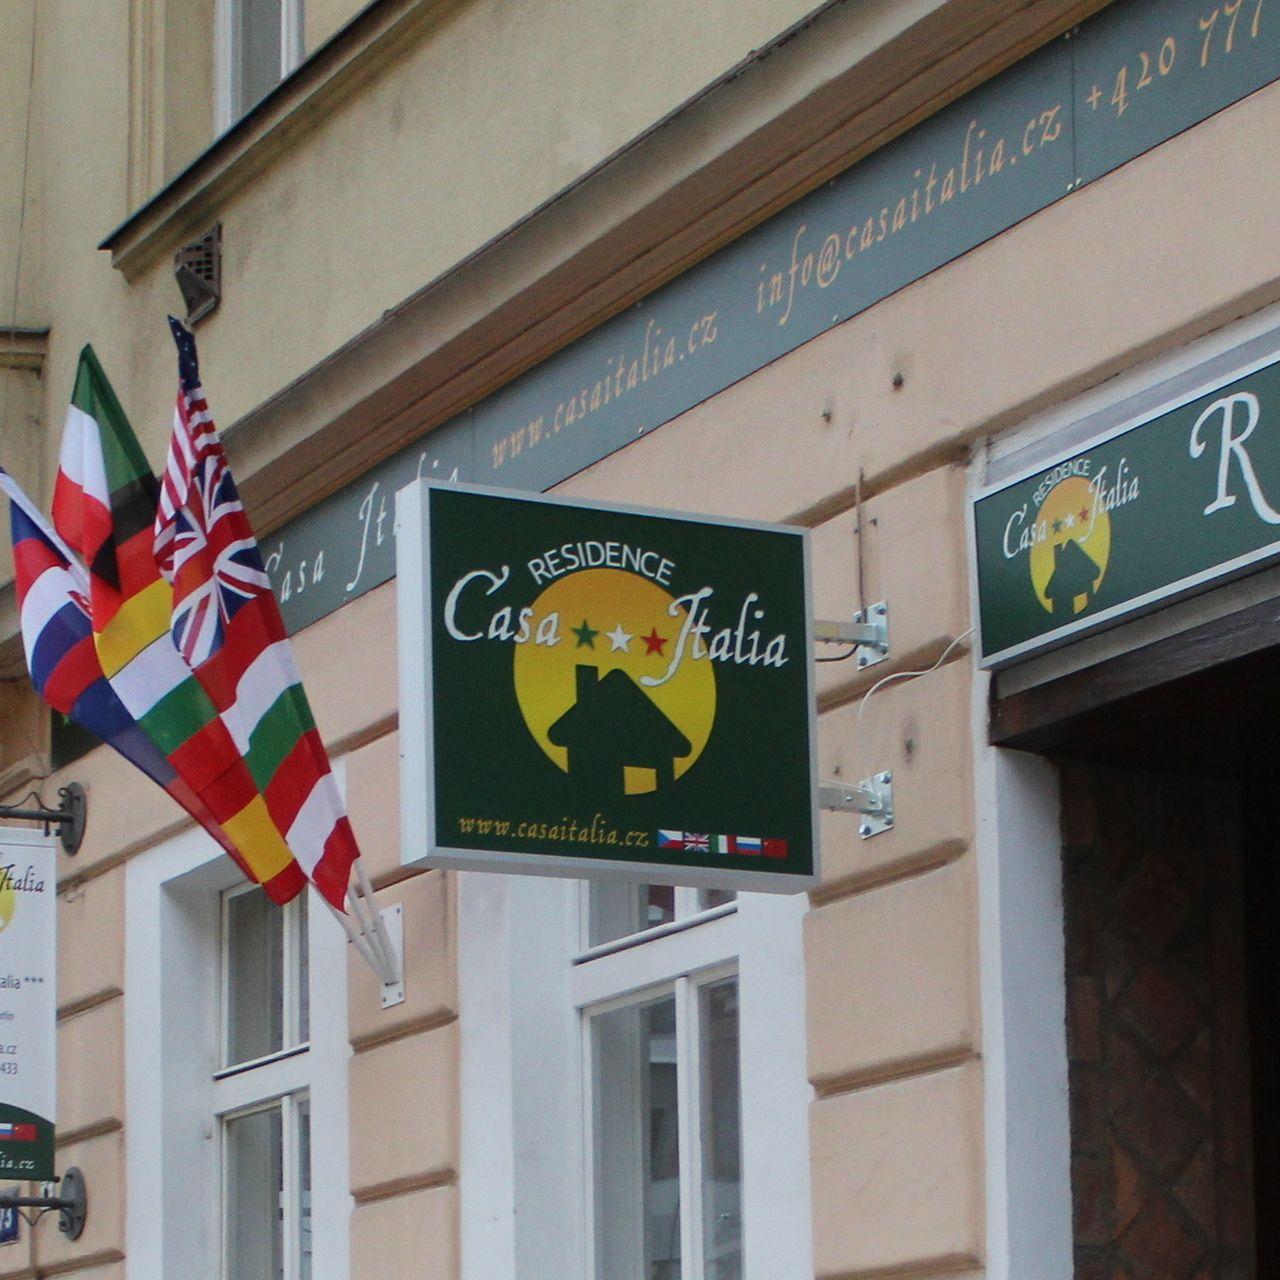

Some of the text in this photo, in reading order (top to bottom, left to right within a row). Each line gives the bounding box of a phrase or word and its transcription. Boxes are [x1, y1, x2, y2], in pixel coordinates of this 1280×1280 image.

[490, 311, 719, 470] www.casaitalia.cz
[754, 104, 1063, 327] info@casaitalia.cz
[1086, 36, 1177, 119] +420
[1032, 458, 1092, 507] RESIDENCE
[1002, 457, 1141, 559] Casa Italia
[527, 540, 675, 586] RESIDENCE
[443, 564, 790, 687] Casa Italia
[457, 812, 650, 849] www.casaitalia.cz
[0, 1061, 19, 1075] 433
